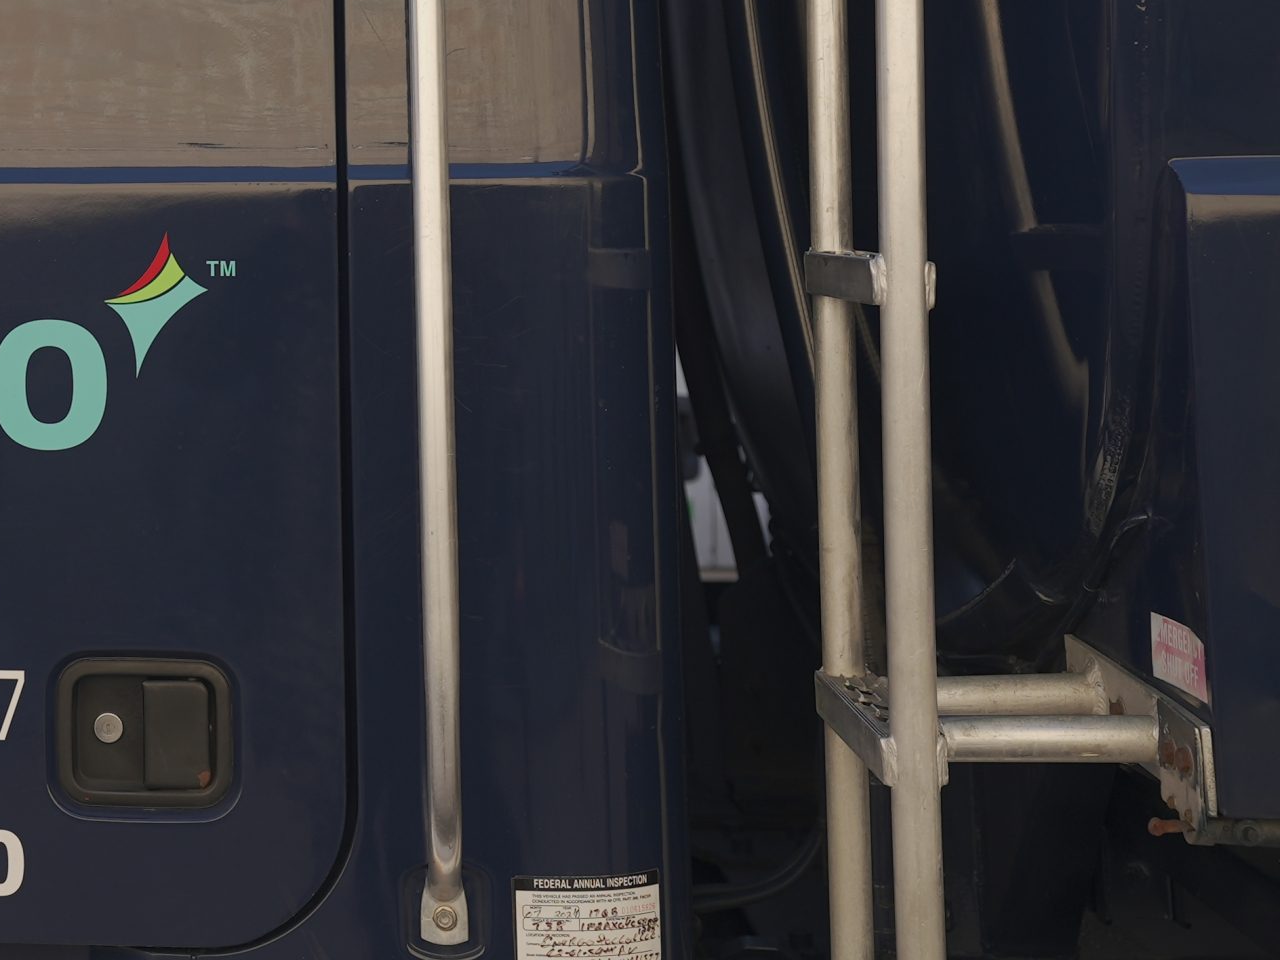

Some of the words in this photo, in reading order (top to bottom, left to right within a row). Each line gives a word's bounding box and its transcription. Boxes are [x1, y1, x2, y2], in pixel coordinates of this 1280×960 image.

[206, 260, 236, 277] TM
[1184, 662, 1199, 688] OFF
[533, 878, 572, 889] FEDERAL
[573, 878, 605, 889] ANNUAL
[606, 874, 648, 888] INSPECTION
